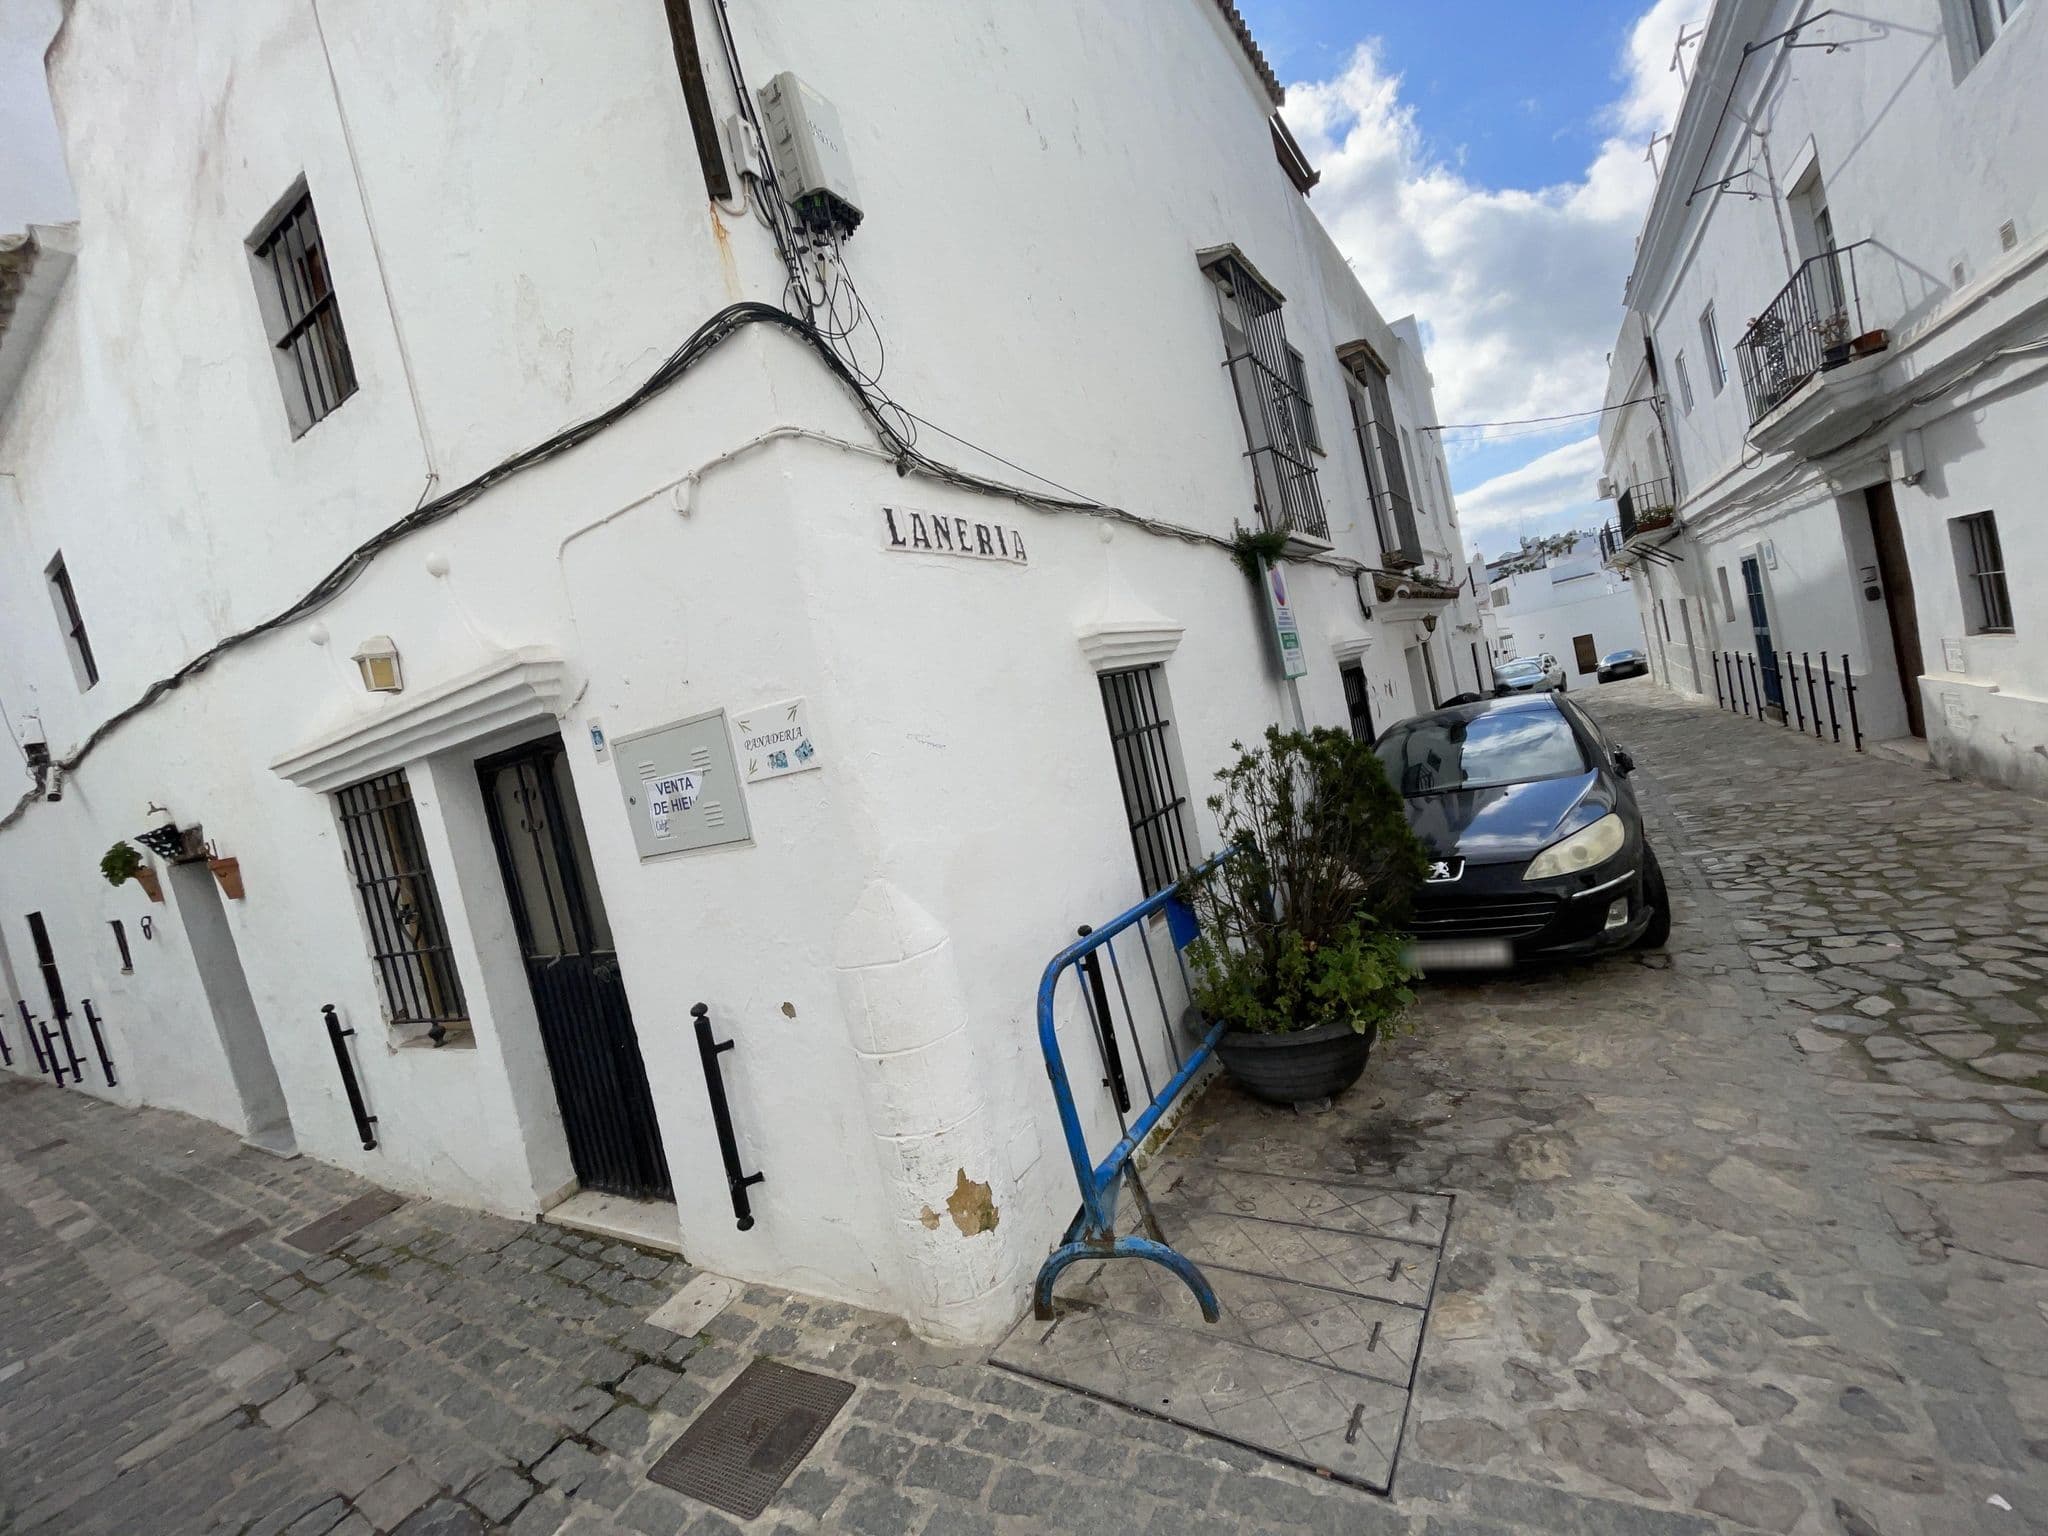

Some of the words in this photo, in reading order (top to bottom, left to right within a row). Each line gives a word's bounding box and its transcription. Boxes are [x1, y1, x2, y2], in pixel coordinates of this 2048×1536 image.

[883, 508, 1027, 560] LANERIA
[744, 726, 803, 751] PANADERIA
[655, 776, 694, 796] VENTA
[653, 801, 669, 816] DE
